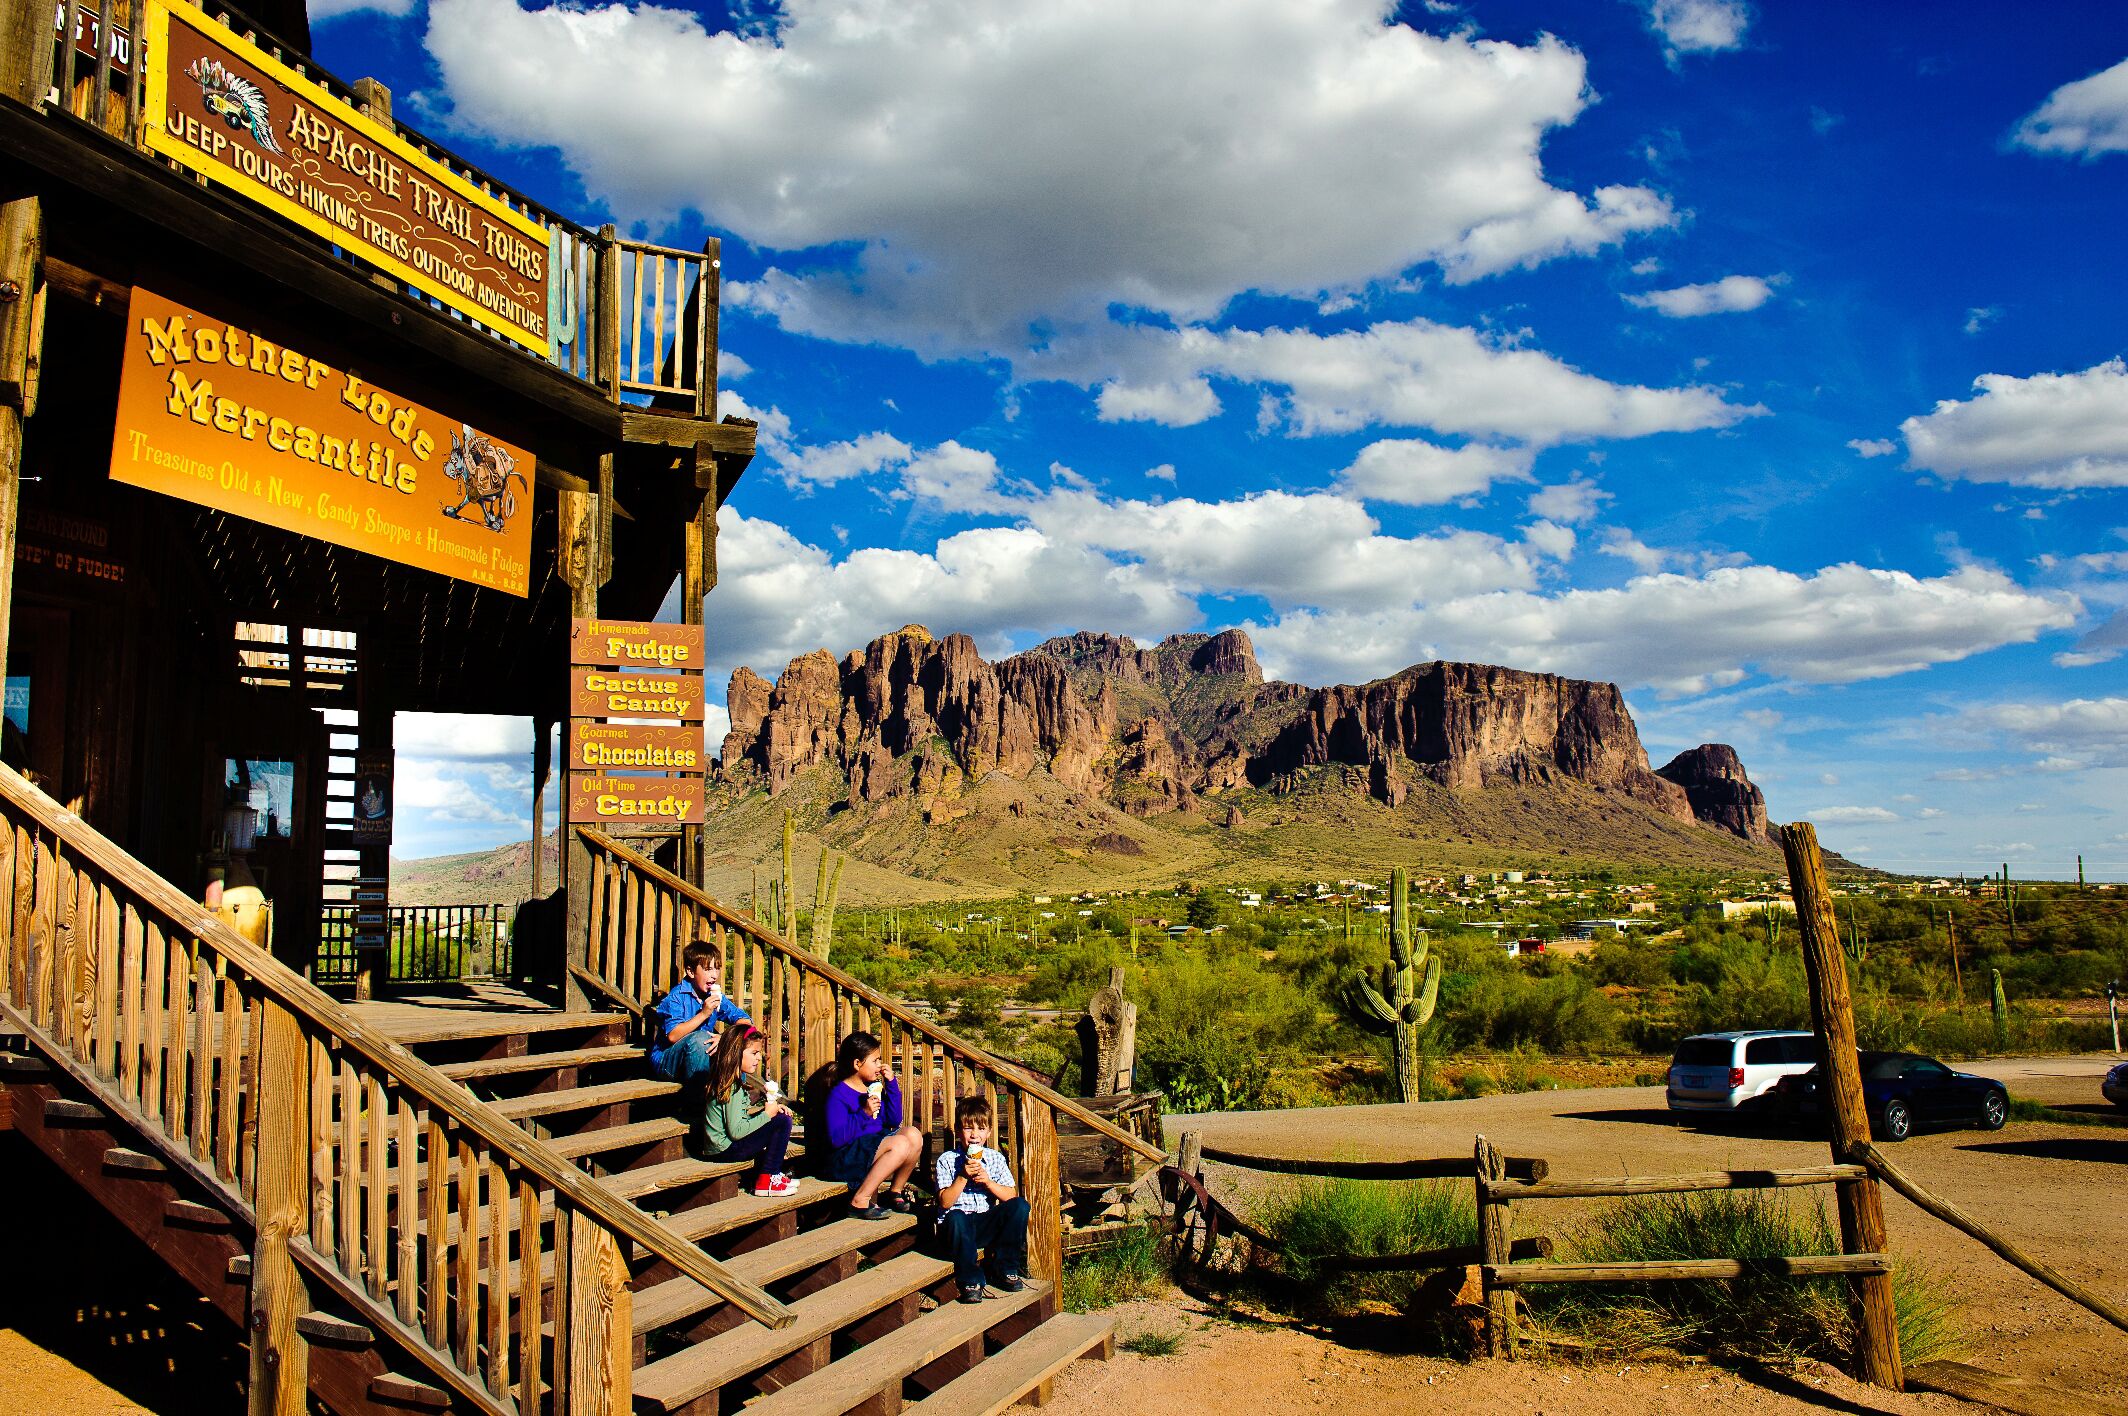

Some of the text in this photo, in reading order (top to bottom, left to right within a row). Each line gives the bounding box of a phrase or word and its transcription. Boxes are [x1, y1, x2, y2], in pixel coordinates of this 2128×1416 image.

[288, 103, 543, 282] APACHE TRAIL TOURS
[167, 111, 544, 337] JEEP TOURS HIKING TREKS OUTDOOR ADVENTURE
[141, 316, 435, 462] Mother Lode
[166, 368, 417, 494] Mercantile
[129, 429, 215, 481] Treasures
[219, 461, 249, 493] Old
[253, 480, 262, 497] &
[317, 493, 360, 530] Candy
[364, 507, 411, 545] Shoppe
[415, 530, 422, 545] &
[426, 526, 488, 565] Homemade
[492, 547, 524, 578] Fudge
[59, 514, 109, 549] ROUND
[55, 551, 73, 571] OF
[76, 556, 126, 583] FUDGE!
[588, 621, 650, 636] Homemade
[606, 637, 689, 666] Fudge
[584, 675, 679, 694] Cactus
[607, 694, 691, 717] Candy
[580, 724, 629, 740] Gourmet
[582, 742, 697, 767] Chocolates
[582, 777, 636, 792] Old Time
[595, 794, 692, 821] Candy
